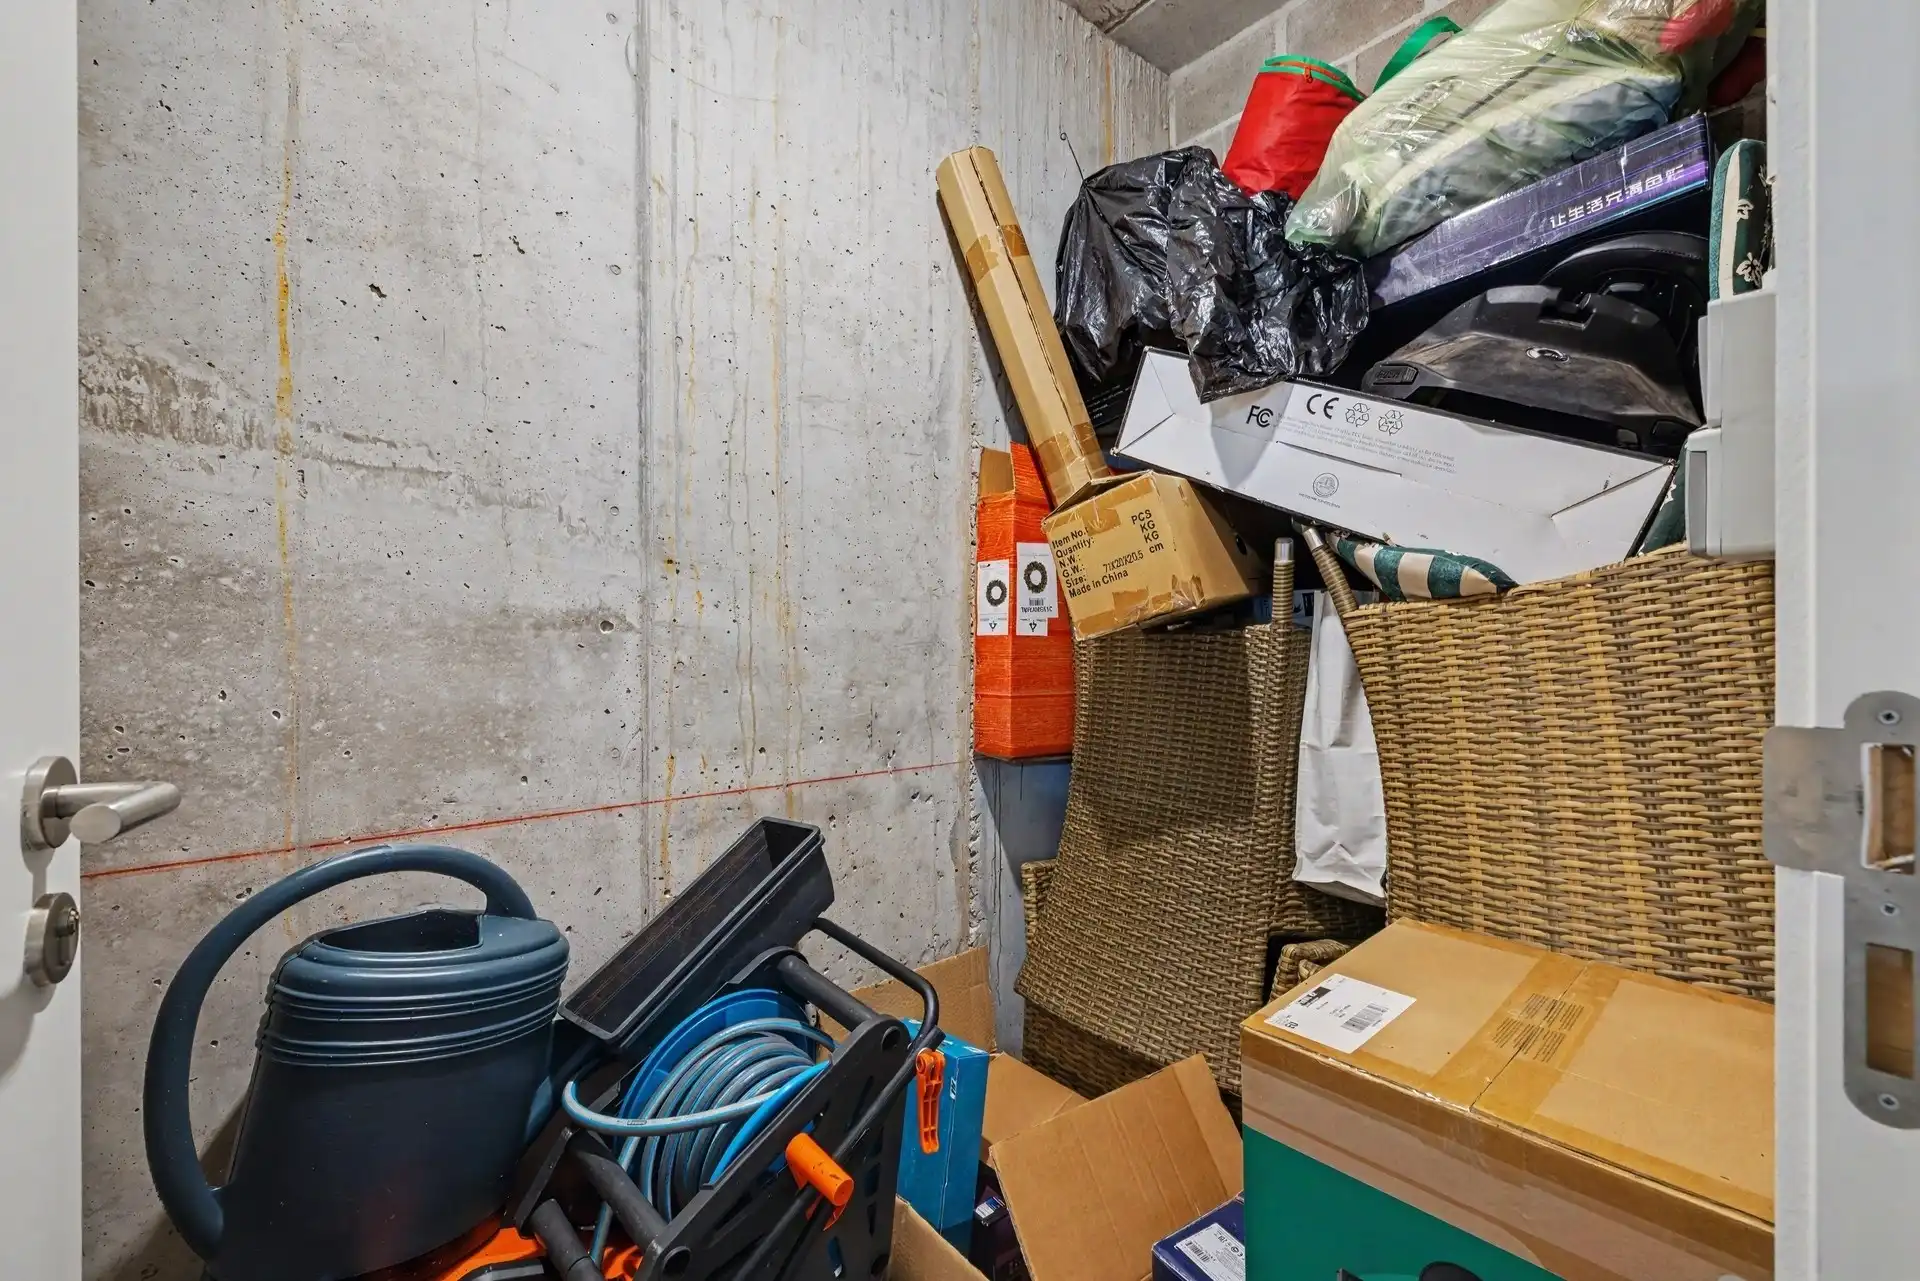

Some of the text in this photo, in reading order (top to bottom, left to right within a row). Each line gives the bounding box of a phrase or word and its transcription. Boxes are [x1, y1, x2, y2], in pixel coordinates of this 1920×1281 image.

[1307, 394, 1339, 419] CE
[1051, 536, 1071, 549] Item
[1055, 509, 1152, 558] Quantity: PCS
[1059, 520, 1155, 568] N.W.: KG
[1062, 530, 1159, 578] G.W.: KG
[1065, 574, 1087, 588] Size:
[1149, 542, 1164, 553] cm
[1068, 569, 1129, 598] Made in China
